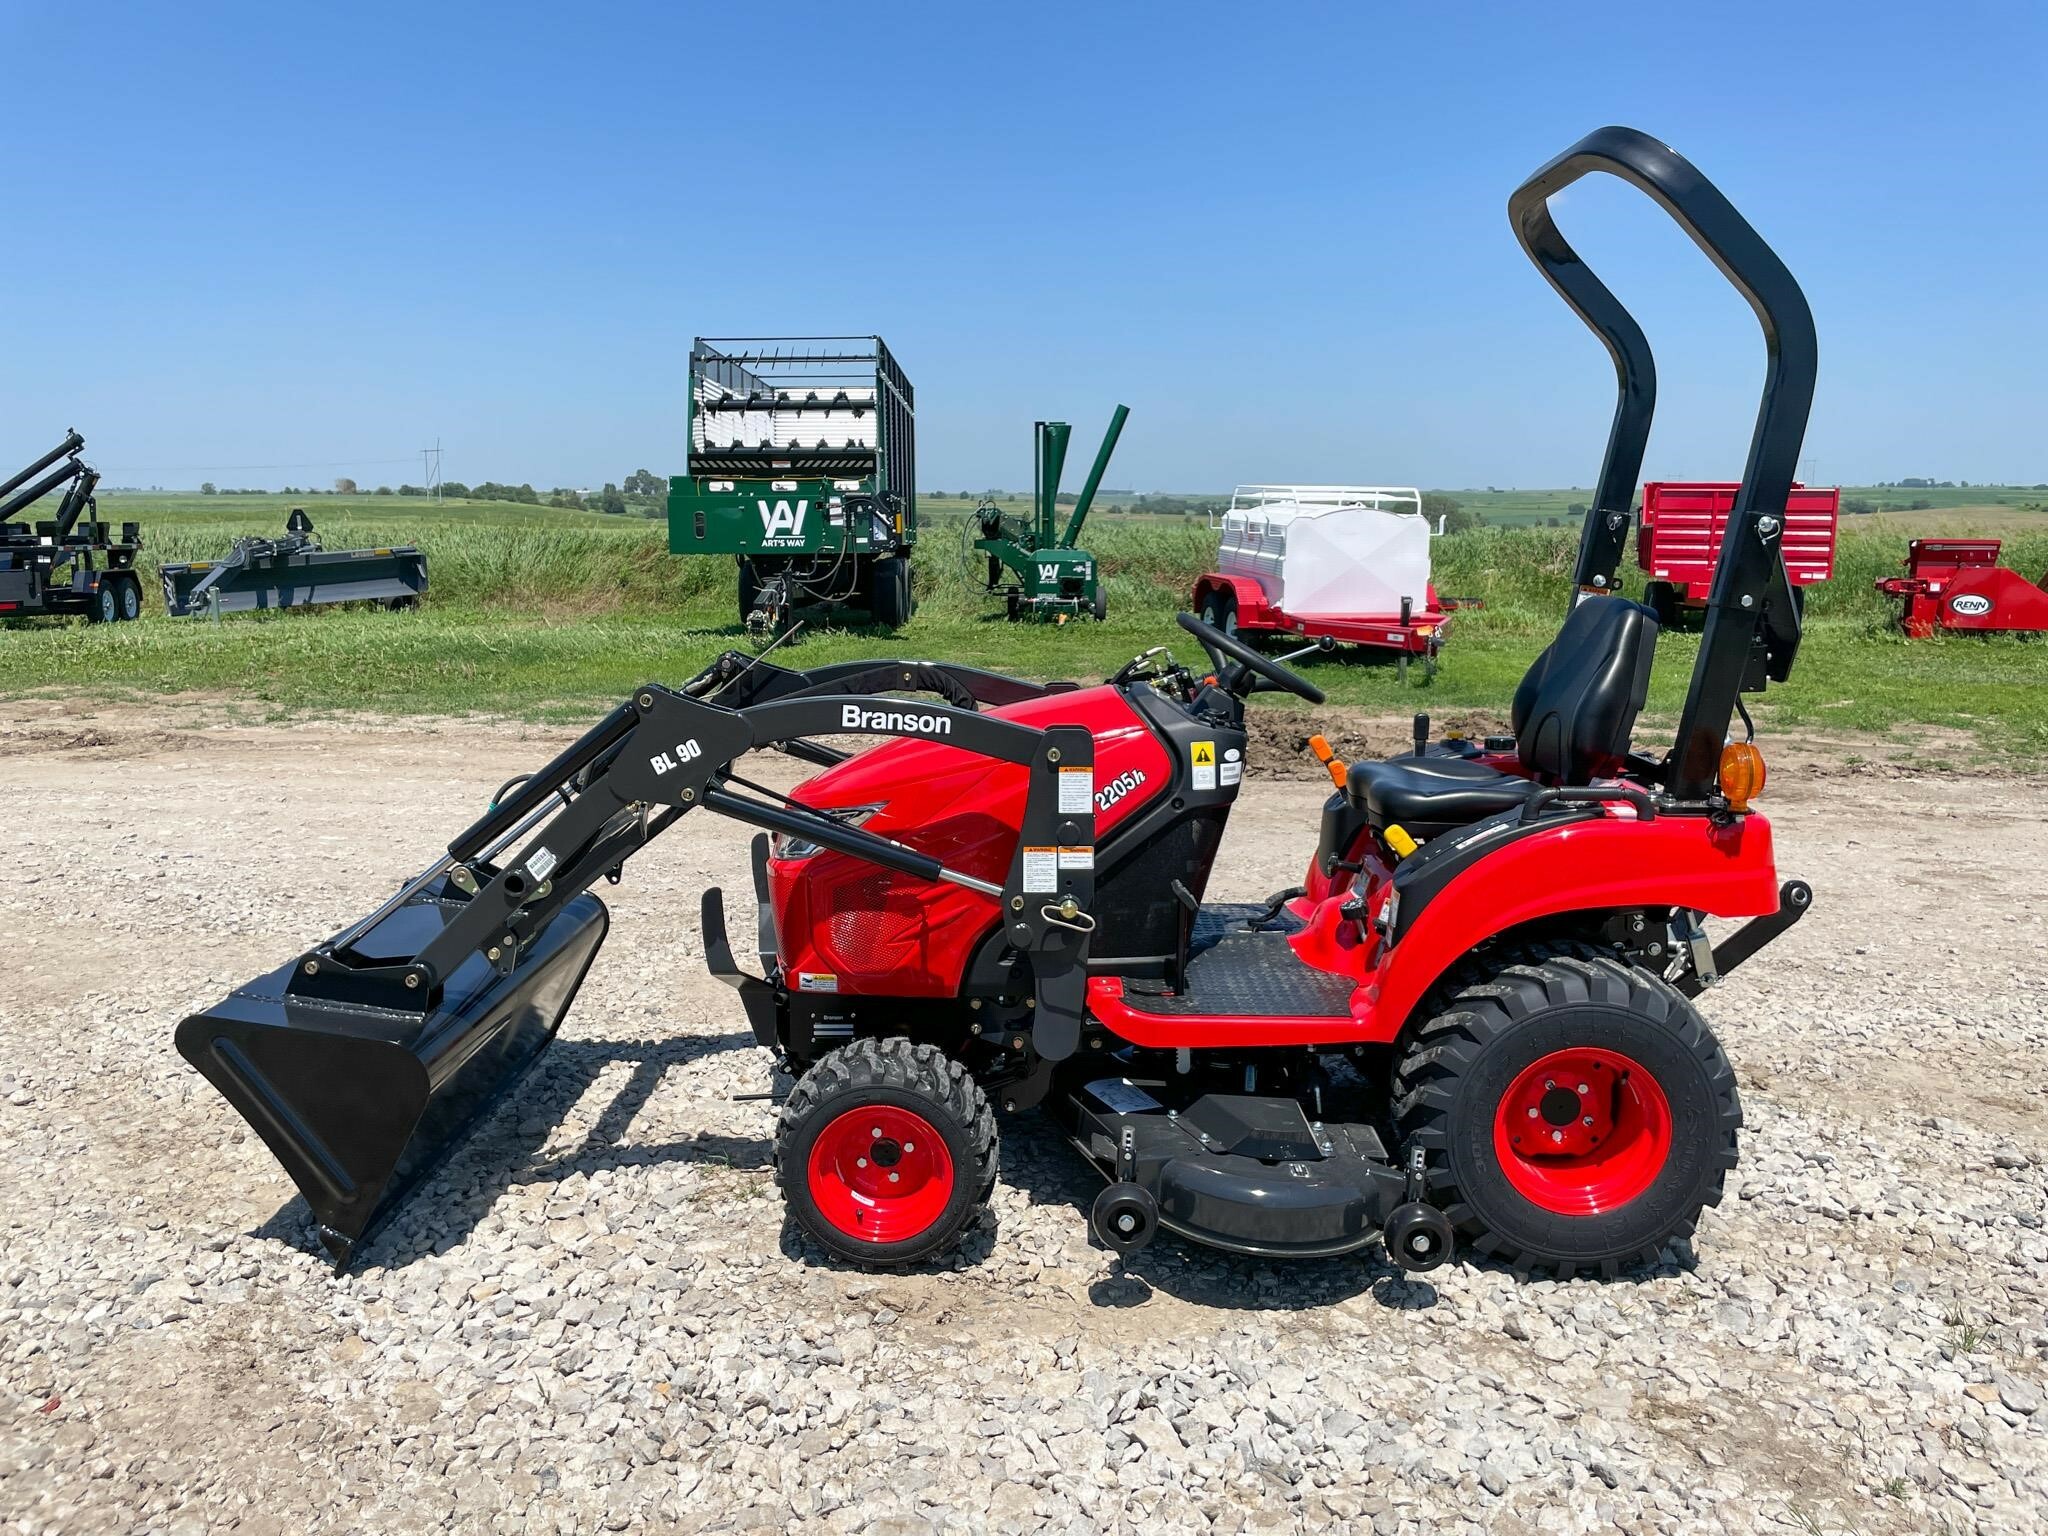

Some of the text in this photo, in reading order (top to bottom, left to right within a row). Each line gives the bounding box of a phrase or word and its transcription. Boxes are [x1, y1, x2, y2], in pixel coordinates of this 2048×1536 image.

[761, 539, 806, 547] ART'S WAY
[1955, 600, 1987, 610] RENN
[841, 704, 951, 734] Branson
[650, 738, 702, 775] BL 90
[1094, 768, 1147, 812] 2205h
